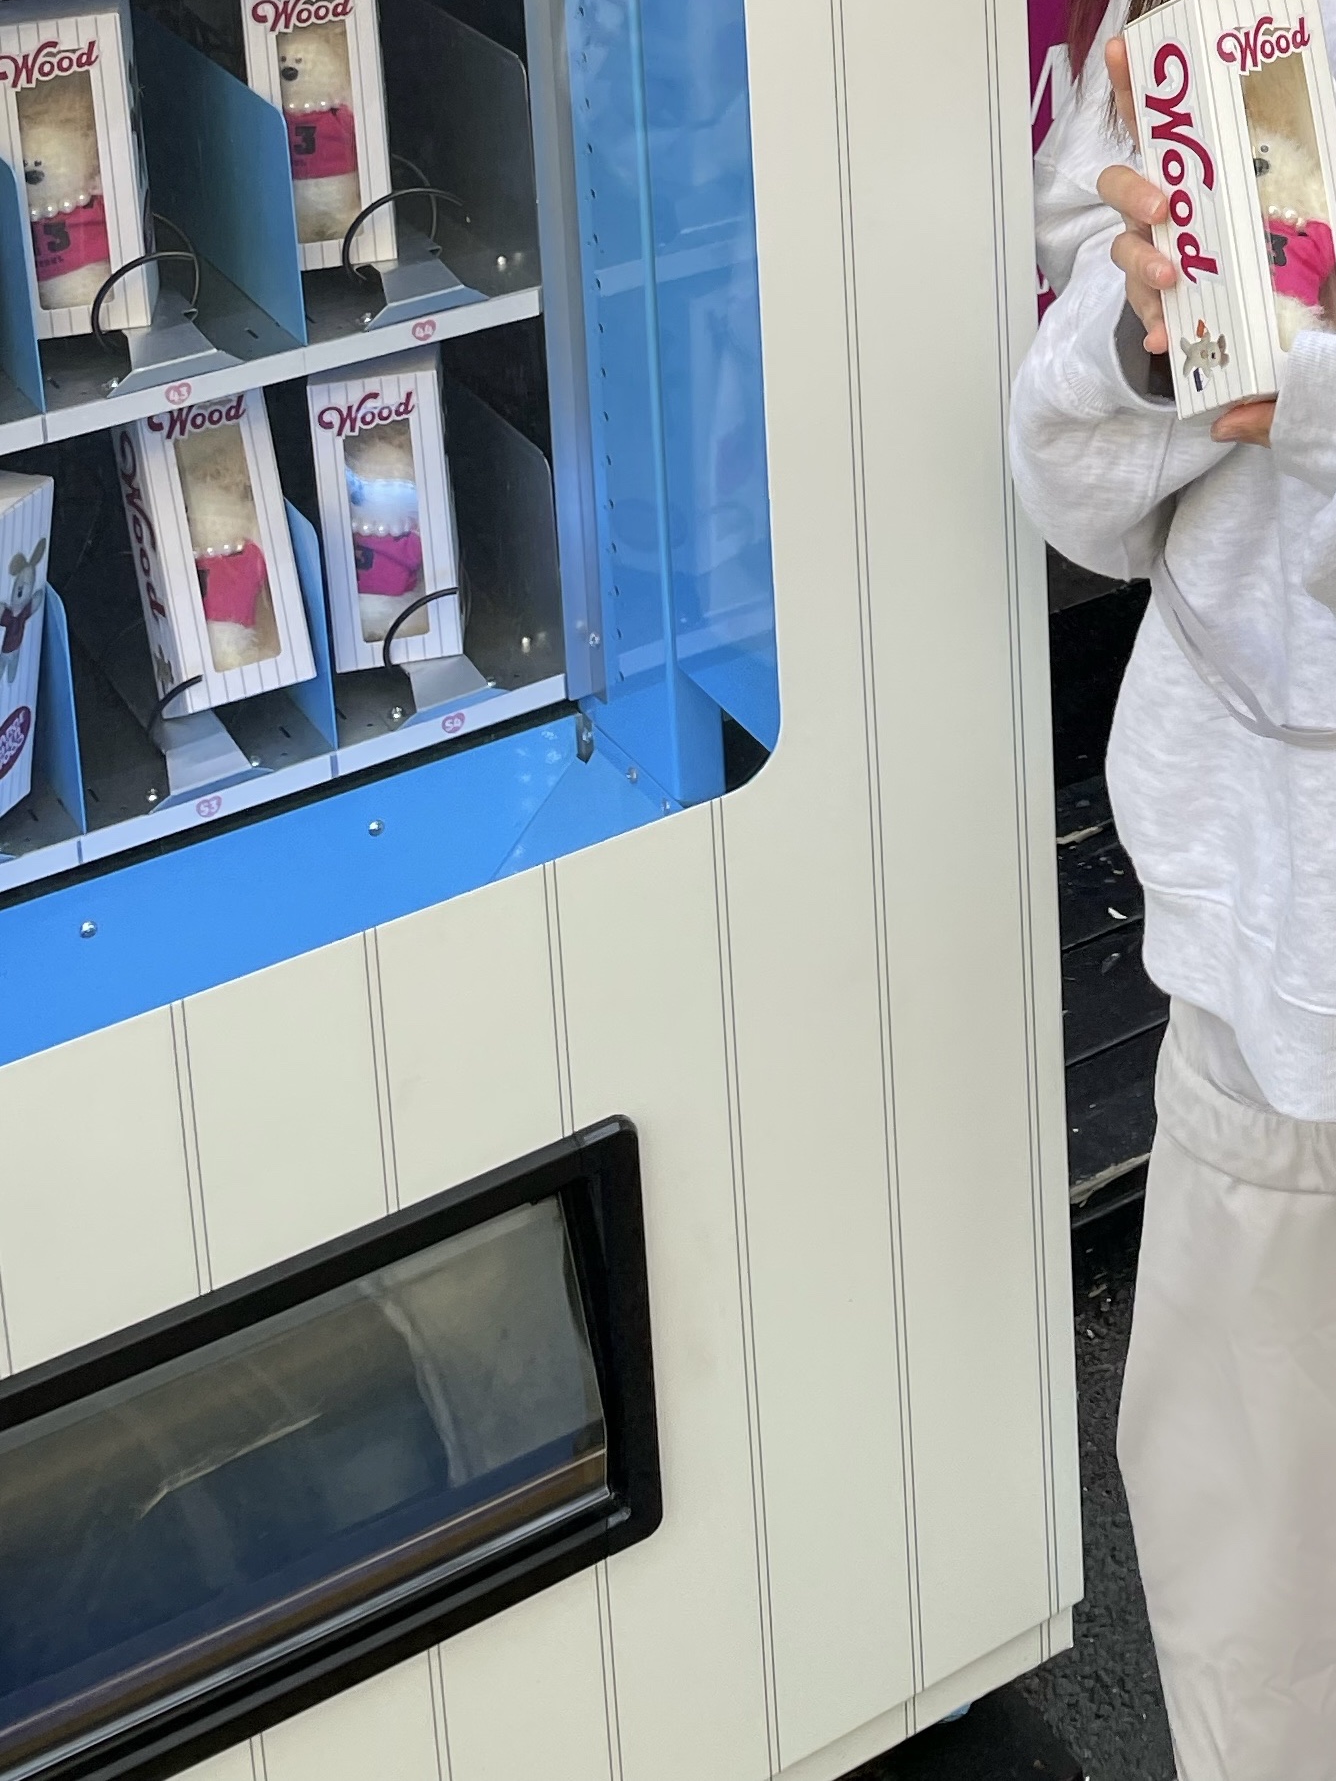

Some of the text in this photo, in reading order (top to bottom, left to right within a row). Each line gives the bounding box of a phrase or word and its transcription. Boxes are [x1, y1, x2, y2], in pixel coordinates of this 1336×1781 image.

[0, 39, 98, 89] Wood
[1217, 15, 1312, 73] Wood
[1144, 43, 1220, 284] Wood
[146, 393, 246, 440] Wood
[317, 391, 415, 437] Wood
[119, 429, 167, 620] Wood
